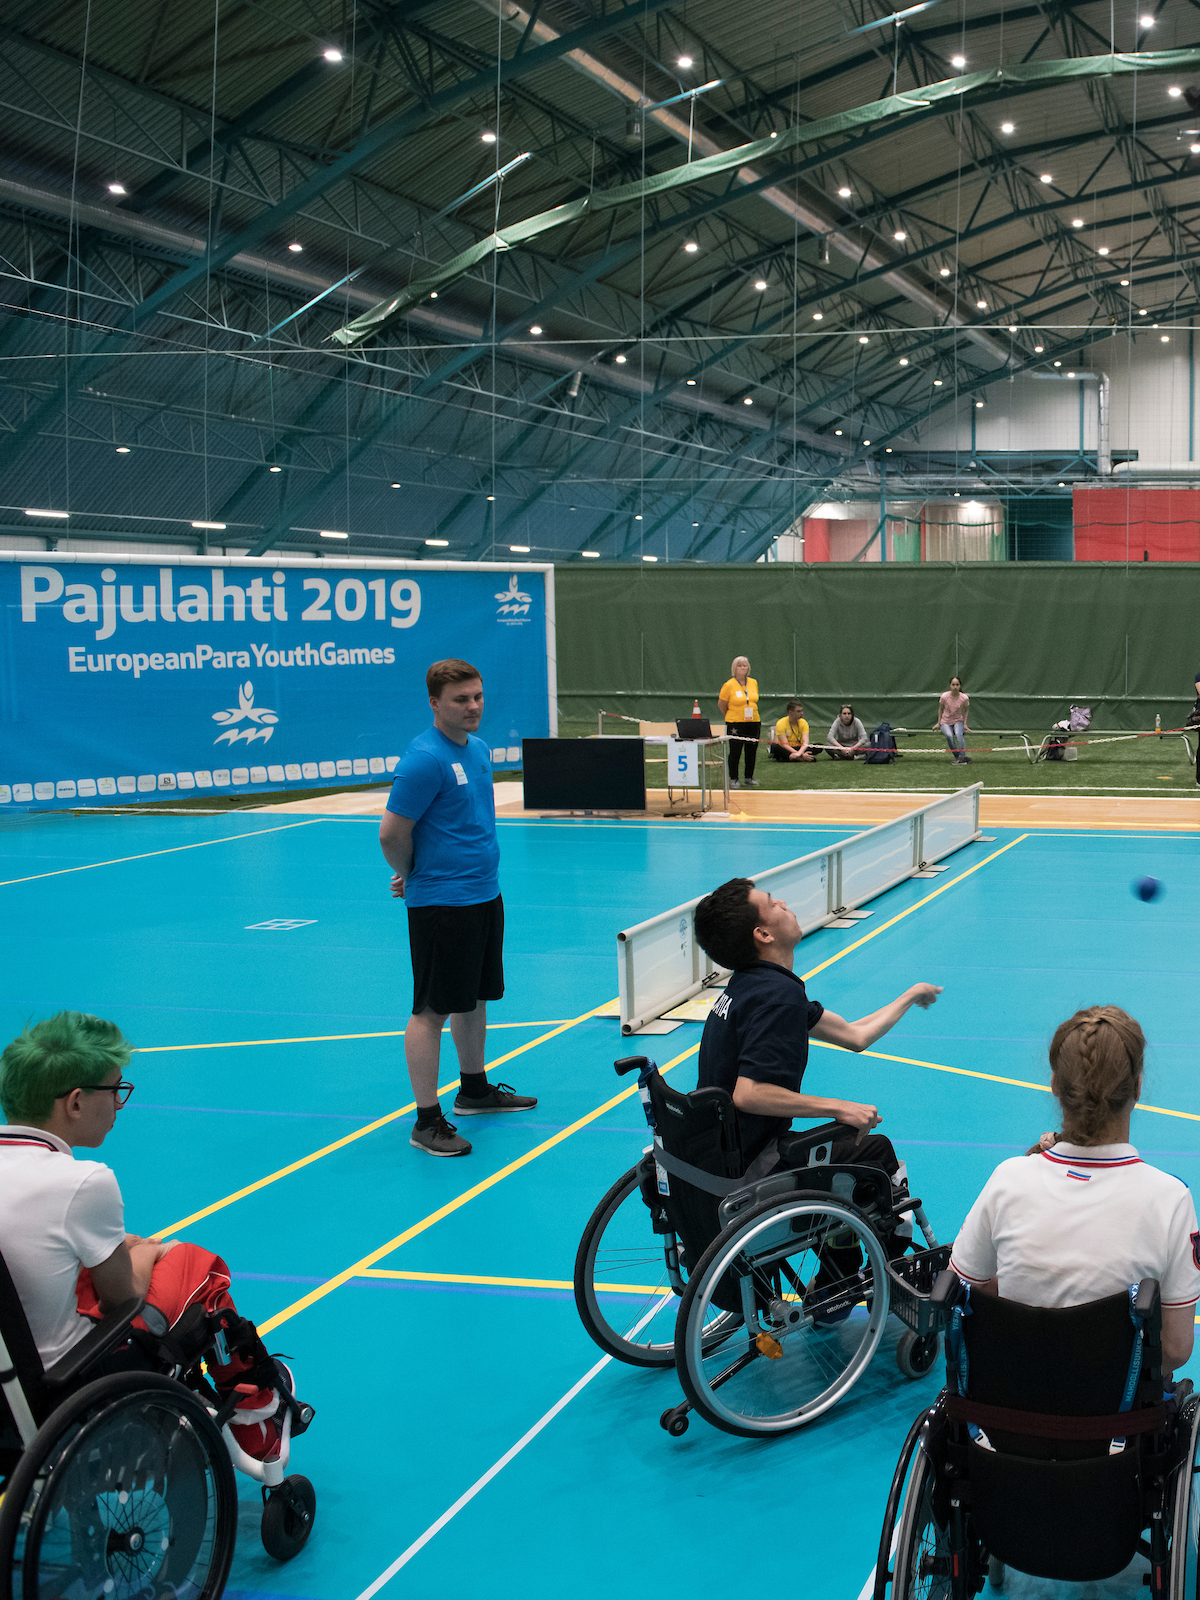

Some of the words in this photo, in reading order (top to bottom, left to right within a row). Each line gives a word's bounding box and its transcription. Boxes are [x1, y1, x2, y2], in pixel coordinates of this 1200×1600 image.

[20, 565, 288, 640] Pajulahti
[301, 578, 421, 628] 2019
[678, 755, 688, 772] 5
